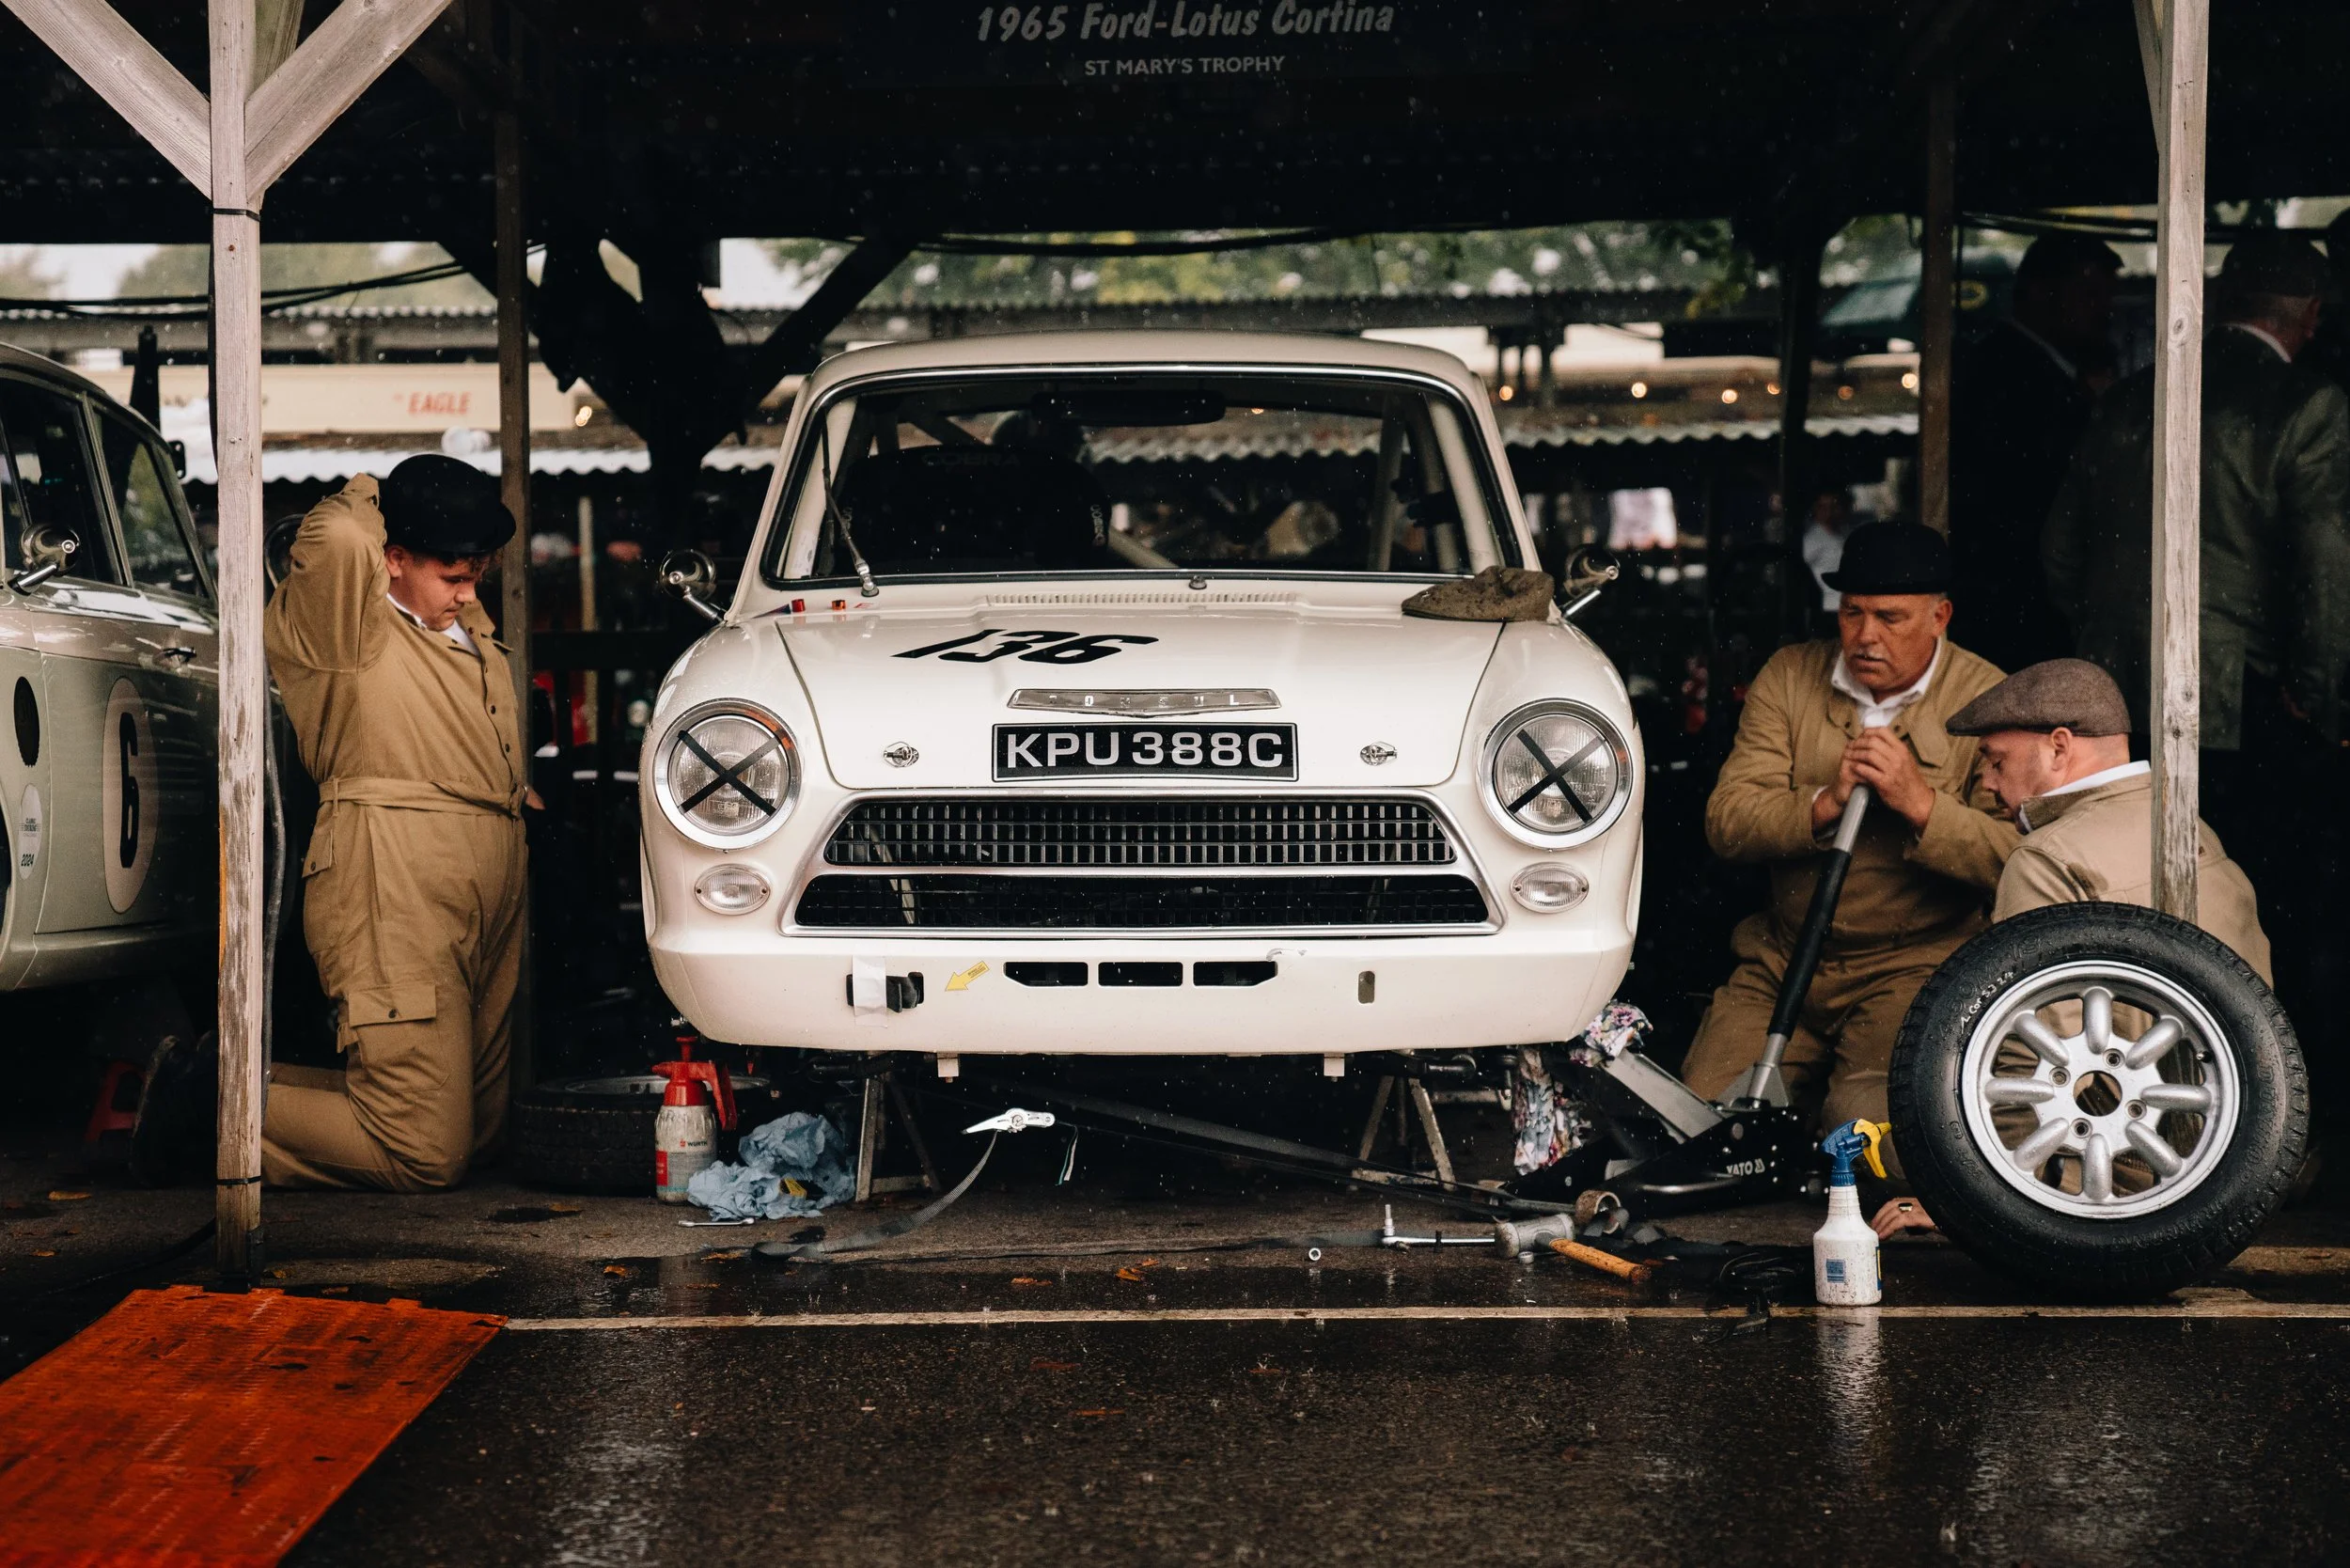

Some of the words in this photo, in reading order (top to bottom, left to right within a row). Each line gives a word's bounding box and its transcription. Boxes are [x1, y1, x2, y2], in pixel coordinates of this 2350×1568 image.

[978, 6, 1068, 42] 1965
[1079, 1, 1261, 40] Ford-Lotus
[1271, 0, 1394, 36] Cortina
[1085, 59, 1109, 75] ST
[1116, 57, 1194, 75] MARY'S
[1199, 55, 1286, 74] TROPHY
[406, 391, 472, 415] EAGLE
[891, 629, 1159, 665] 136
[1007, 731, 1119, 769] KPU
[119, 712, 139, 869] 6
